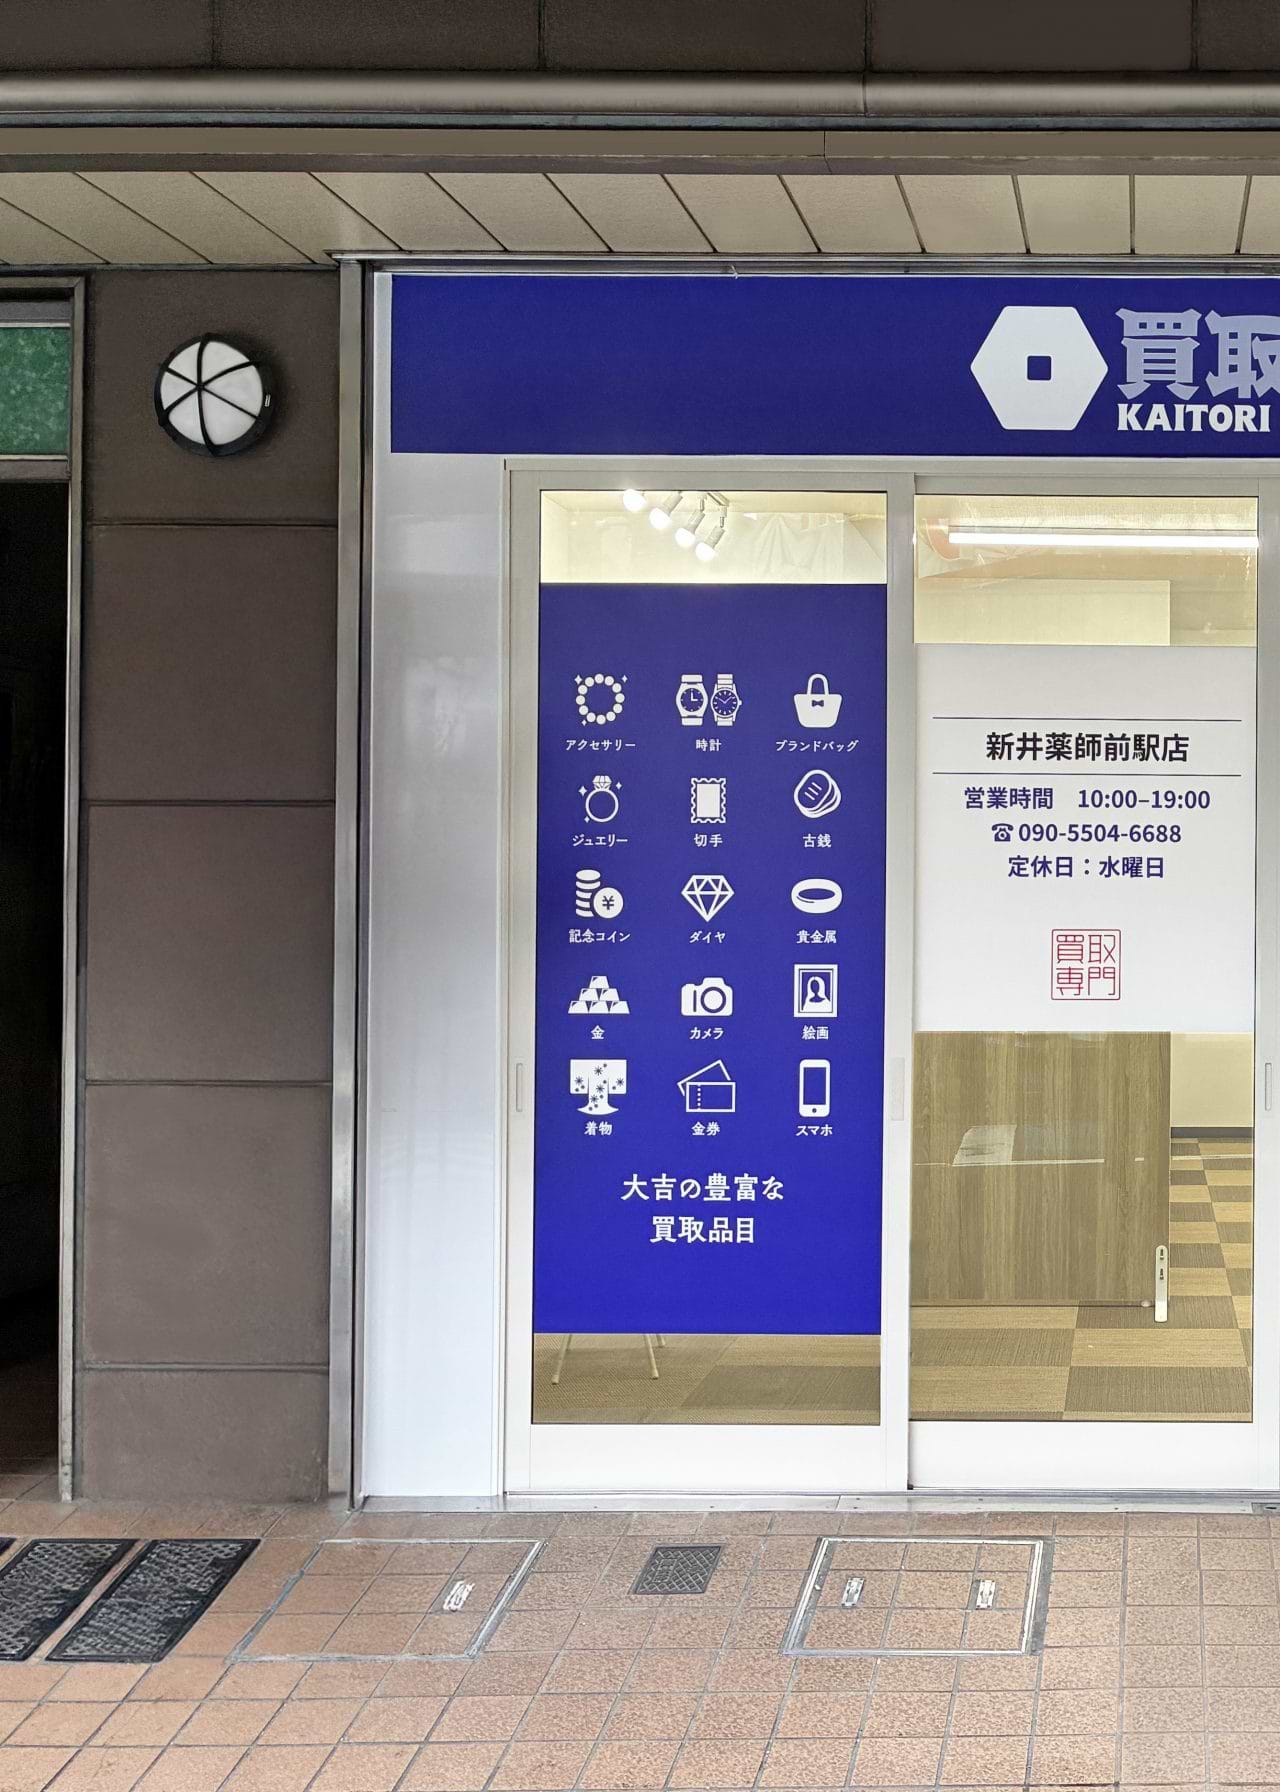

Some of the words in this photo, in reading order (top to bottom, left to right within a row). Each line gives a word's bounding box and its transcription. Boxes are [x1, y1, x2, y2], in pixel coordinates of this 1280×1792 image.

[1118, 404, 1270, 432] KAITORI
[567, 739, 635, 751] アクセサリー
[696, 739, 721, 751] 時計
[776, 740, 859, 752] ブランドバッグ
[987, 732, 1189, 762] 新井薬師前駅店
[965, 787, 1053, 809] 営業時間
[694, 833, 722, 847] 切手
[1019, 824, 1181, 842] 090-5504-6688
[573, 834, 627, 847] ジュエリー
[803, 834, 831, 847] 古銭
[1008, 855, 1163, 878] 定休日：水曜日
[569, 929, 630, 943] 記念コイン
[690, 931, 725, 943] ダイヤ
[797, 930, 836, 943] 貴金属
[1056, 935, 1115, 964] 買取
[591, 1025, 604, 1039] 金
[690, 1027, 723, 1039] カメラ
[802, 1025, 828, 1040] 絵画
[585, 1121, 612, 1135] 着物
[692, 1121, 720, 1136] 金券
[796, 1124, 832, 1136] スマホ
[621, 1173, 783, 1201] 大吉の豊富な
[650, 1216, 753, 1243] 買取品目
